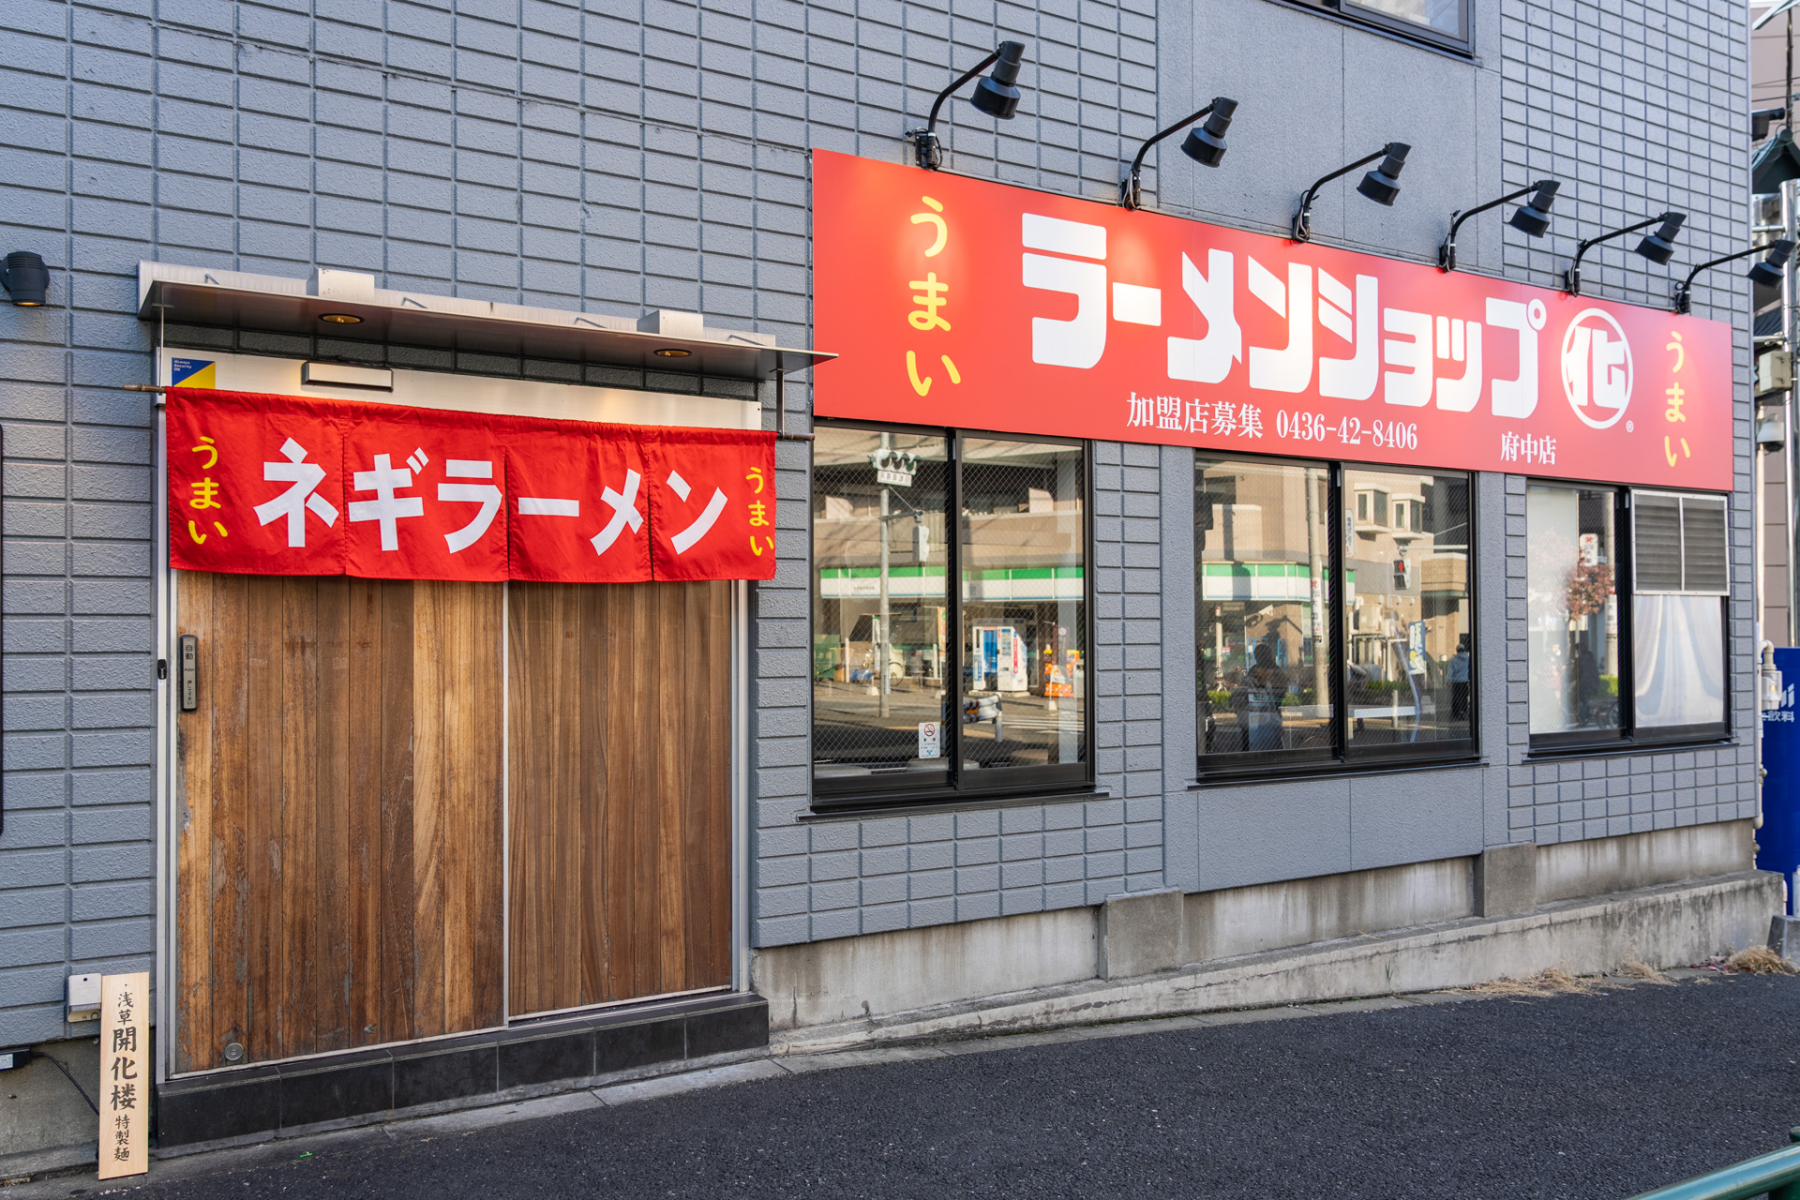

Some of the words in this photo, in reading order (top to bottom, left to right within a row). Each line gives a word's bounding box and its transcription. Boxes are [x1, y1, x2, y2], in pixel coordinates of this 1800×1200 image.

[906, 195, 962, 397] うまい
[1021, 212, 1548, 419] ラーメンショップ
[1126, 391, 1264, 440] 加盟店募集
[1275, 408, 1418, 451] 0436-42-8406
[1499, 431, 1557, 466] 府中店
[1664, 330, 1691, 468] うまい
[187, 436, 229, 545] うまい
[253, 436, 729, 556] ネギラーメン
[745, 466, 775, 557] うまい
[185, 645, 193, 660] 自動
